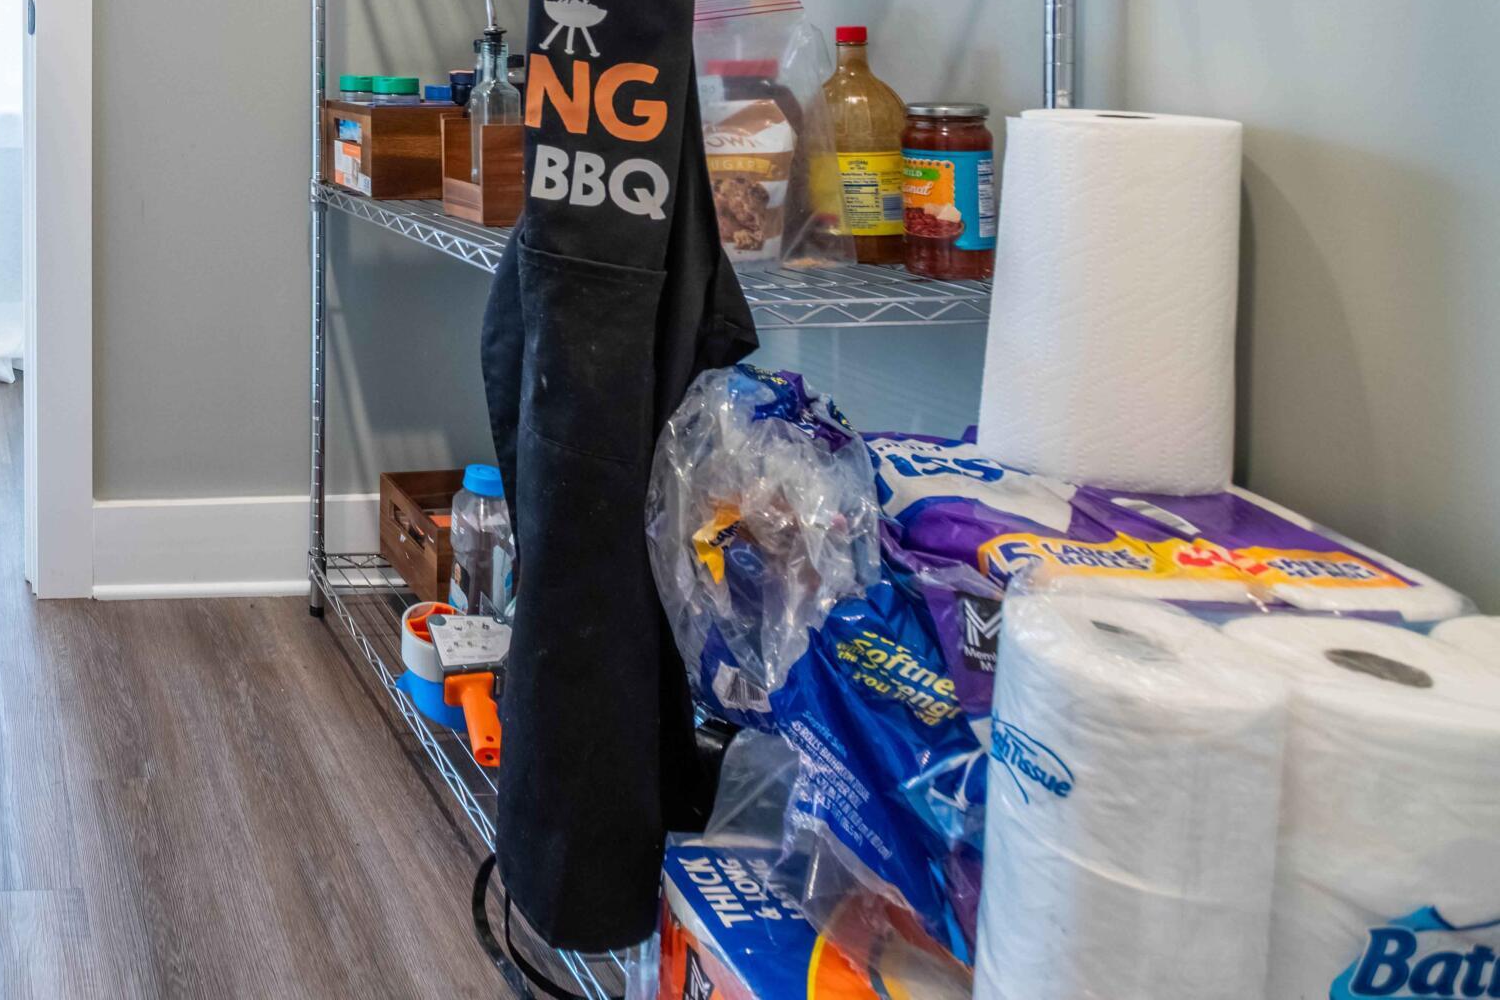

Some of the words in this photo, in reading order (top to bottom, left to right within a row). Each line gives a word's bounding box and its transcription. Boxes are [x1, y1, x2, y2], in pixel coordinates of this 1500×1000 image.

[530, 143, 670, 220] BBQ
[1003, 726, 1073, 798] Tissue
[676, 856, 754, 929] THICK
[715, 856, 771, 902] LONG
[1349, 926, 1500, 999] Bat
